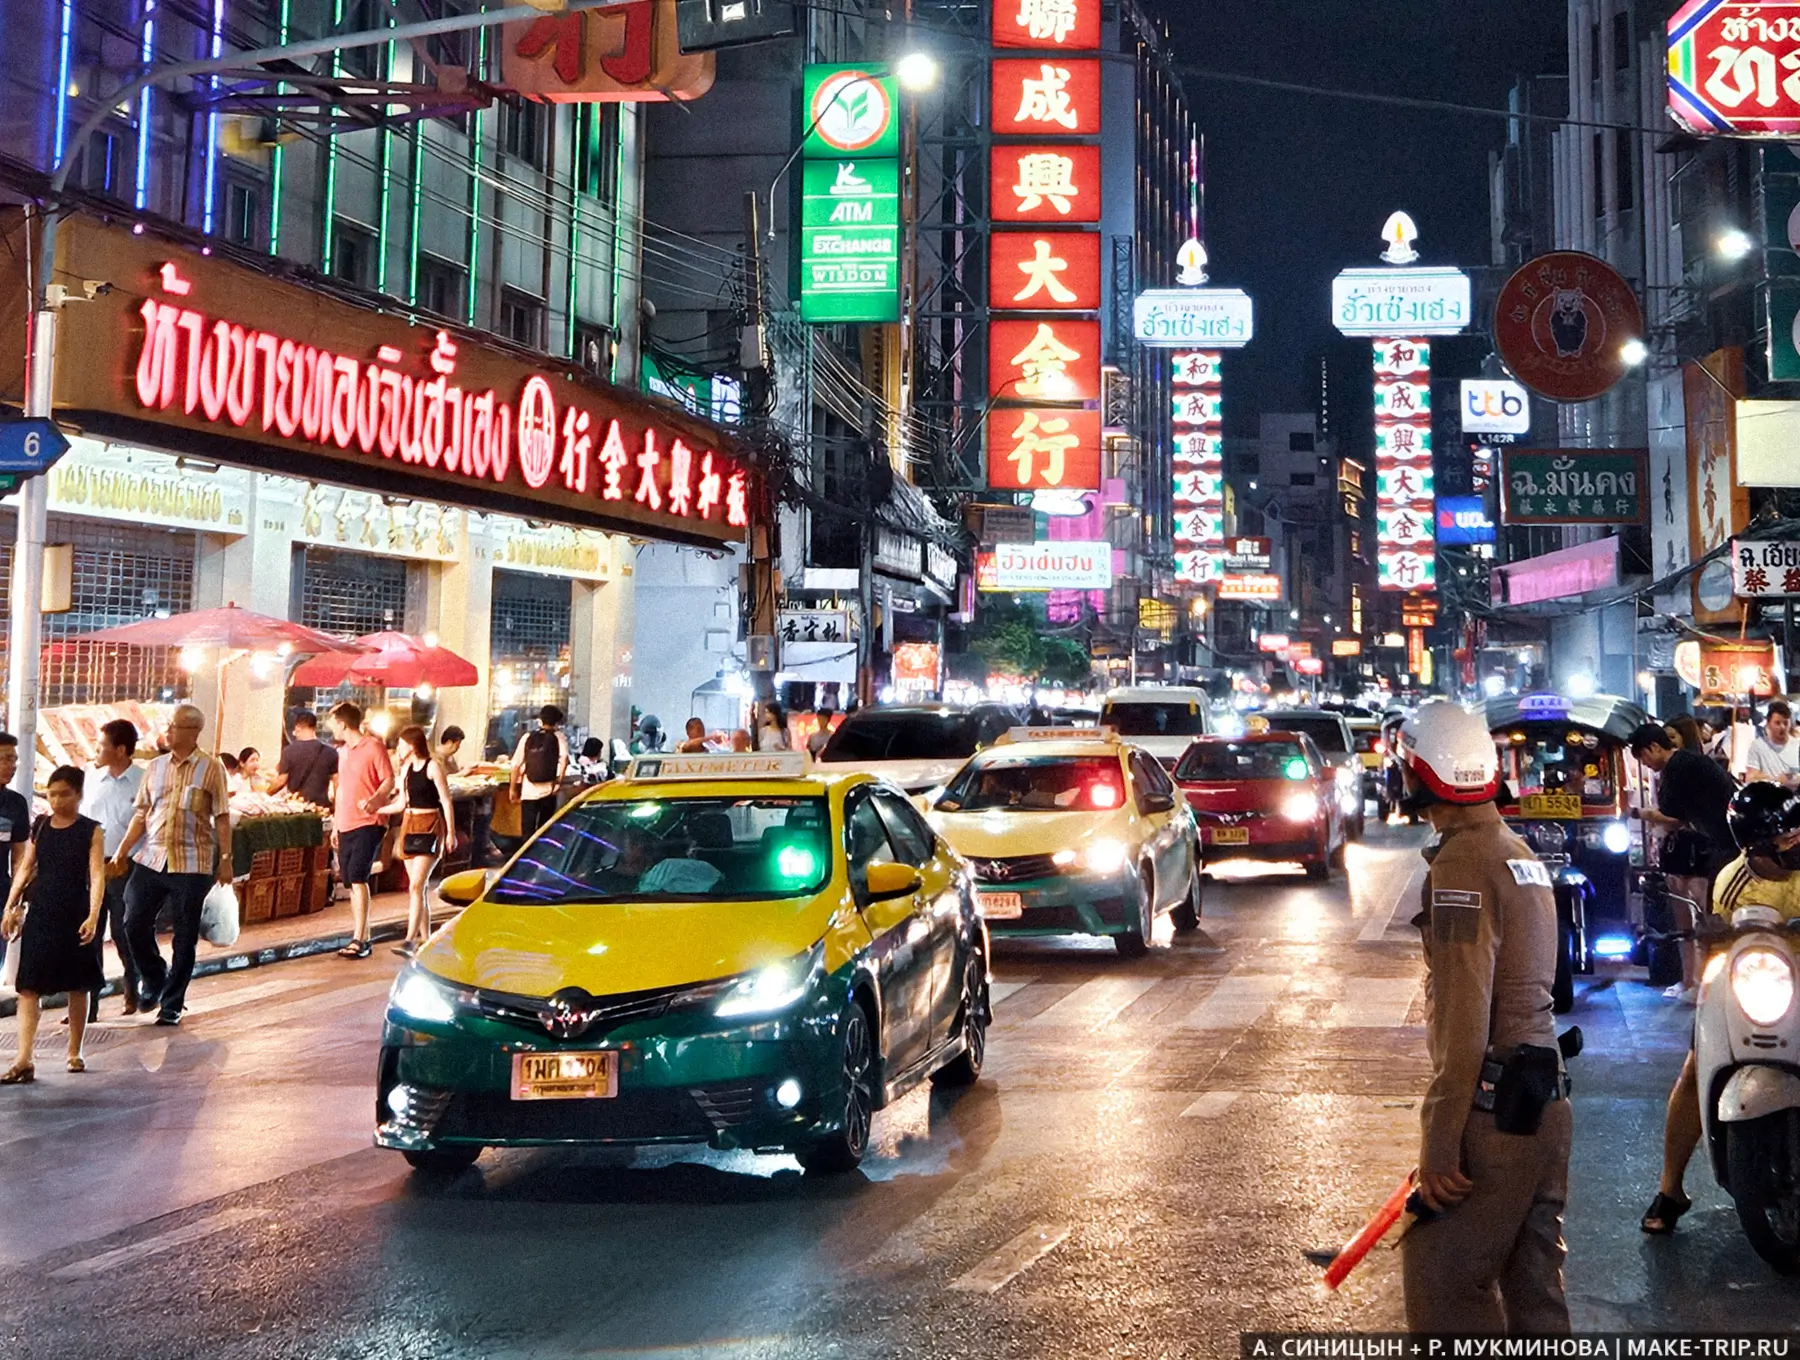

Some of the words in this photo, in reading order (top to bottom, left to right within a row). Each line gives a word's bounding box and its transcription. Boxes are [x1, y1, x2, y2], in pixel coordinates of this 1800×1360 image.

[829, 201, 873, 222] ATM
[812, 269, 887, 283] WISDOM
[1468, 390, 1523, 417] ttb
[24, 431, 39, 457] 6
[1185, 356, 1210, 581] 和成興大金行
[1389, 344, 1420, 581] 和成興大金行
